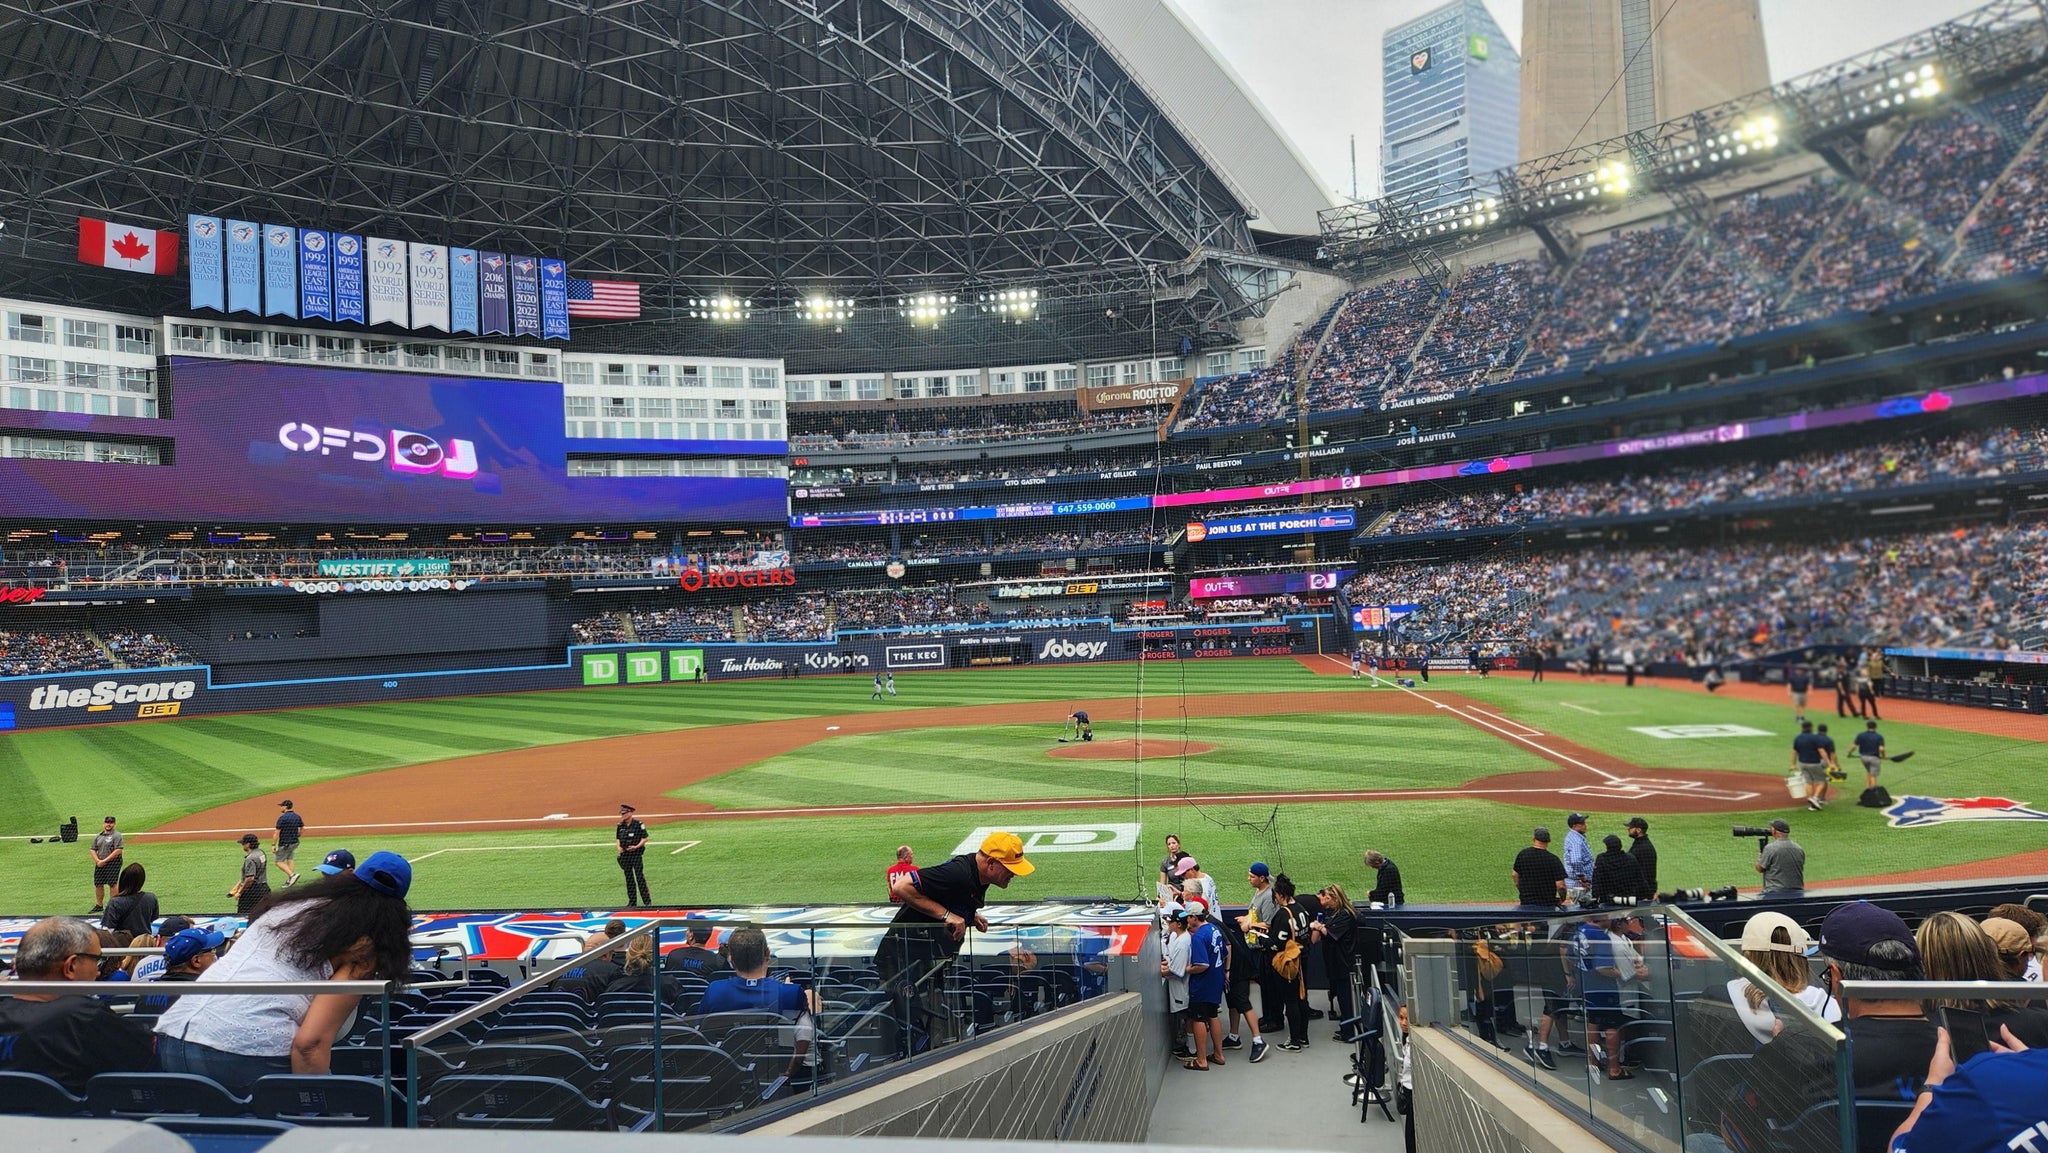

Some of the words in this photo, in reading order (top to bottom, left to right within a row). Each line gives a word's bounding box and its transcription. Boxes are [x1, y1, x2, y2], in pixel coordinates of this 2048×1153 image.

[194, 239, 218, 250] 1985
[232, 244, 255, 254] 1989
[270, 249, 290, 258] 1991
[305, 252, 326, 263] 1992
[338, 256, 359, 267] 1993
[194, 265, 219, 274] EAST
[373, 261, 402, 275] 1992
[416, 265, 444, 280] 1993
[232, 269, 256, 278] EAST
[268, 274, 293, 282] EAST
[338, 273, 360, 281] LEAGUE
[455, 270, 473, 279] 2015
[484, 273, 503, 282] 2016
[305, 276, 327, 286] EAST
[338, 280, 360, 289] EAST
[372, 276, 404, 287] WORLD
[414, 280, 444, 291] WORLD
[545, 279, 564, 289] 2025
[372, 285, 404, 296] SERIES
[485, 284, 505, 293] ALDS
[516, 282, 535, 291] 2016
[338, 288, 360, 296] CHAMPS
[414, 290, 445, 300] SERIES
[454, 292, 474, 301] EAST
[484, 292, 505, 300] CHAMPS
[306, 296, 328, 306] ALCS
[516, 294, 536, 303] 2020
[306, 305, 329, 313] CHAMPS
[339, 299, 361, 309] ALCS
[546, 301, 564, 309] EAST
[455, 311, 475, 320] ALDS
[517, 306, 536, 315] 2022
[518, 319, 537, 328] 2023
[547, 319, 566, 327] ALCS
[1096, 392, 1130, 404] Corona
[1132, 386, 1178, 400] ROOFTOP
[1390, 401, 1414, 409] JACKIE
[1416, 393, 1455, 404] ROBINSON
[1419, 432, 1456, 443] BAUTISTA
[1310, 447, 1345, 457] HALLADAY
[1213, 459, 1242, 468] BEESTON
[1021, 478, 1046, 486] GASTON
[1058, 502, 1116, 513] 647-559-0060
[1209, 525, 1228, 534] JOIN
[1230, 524, 1242, 532] US
[1245, 523, 1257, 531] AT
[1259, 521, 1277, 530] THE
[708, 568, 796, 588] ROGERS
[362, 582, 402, 590] BLUE
[412, 581, 448, 589] JAYS
[998, 584, 1062, 598] theScore
[1068, 584, 1096, 593] BET
[1202, 628, 1232, 636] ROGERS
[1040, 638, 1107, 659] Sobeys
[1262, 647, 1291, 655] ROGERS
[893, 652, 914, 661] THE
[918, 651, 938, 660] KEG
[587, 660, 615, 678] TD
[630, 658, 657, 676] TD
[672, 655, 700, 674] TD
[721, 658, 743, 672] Tim
[744, 657, 784, 671] Horton
[29, 681, 196, 710] theScore
[142, 704, 178, 714] BET
[683, 958, 703, 969] KIRK
